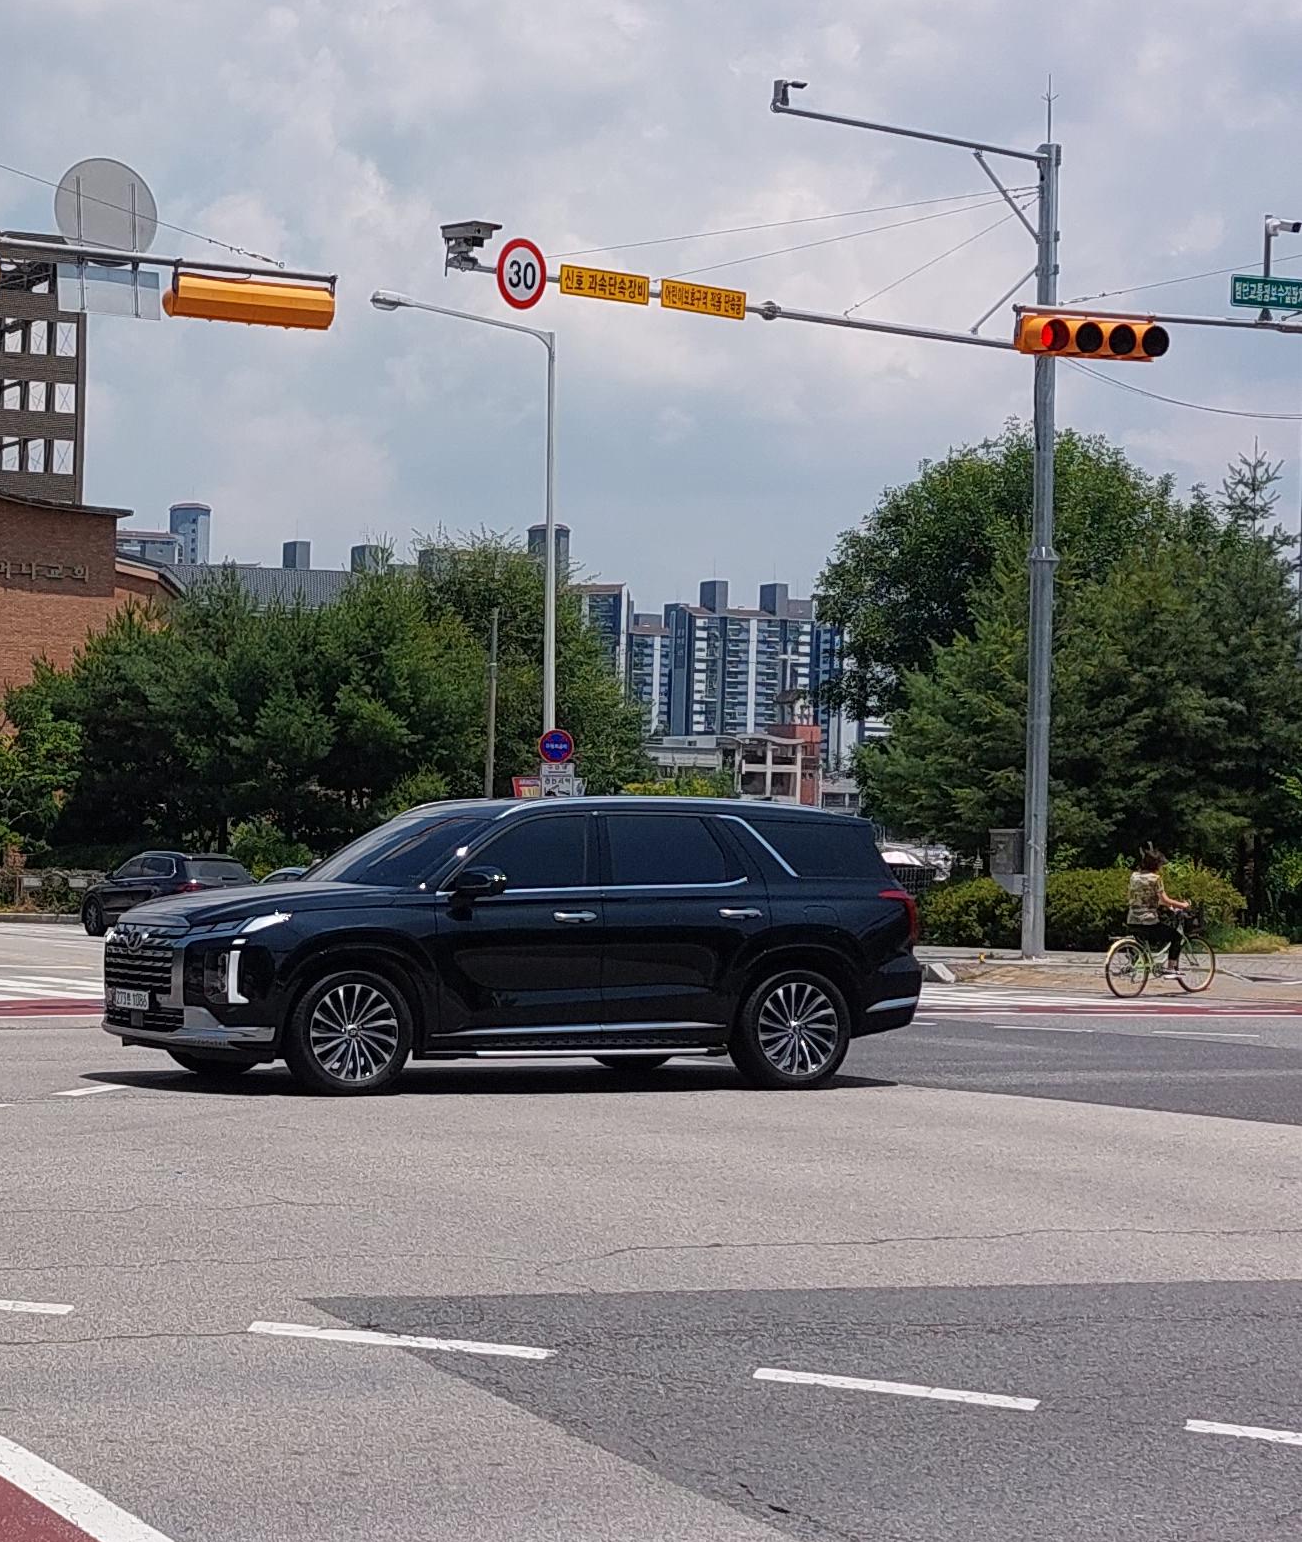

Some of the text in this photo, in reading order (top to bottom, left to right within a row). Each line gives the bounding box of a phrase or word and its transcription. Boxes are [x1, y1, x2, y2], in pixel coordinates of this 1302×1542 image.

[507, 260, 536, 291] 30
[564, 269, 646, 302] 신호 과속단속장비
